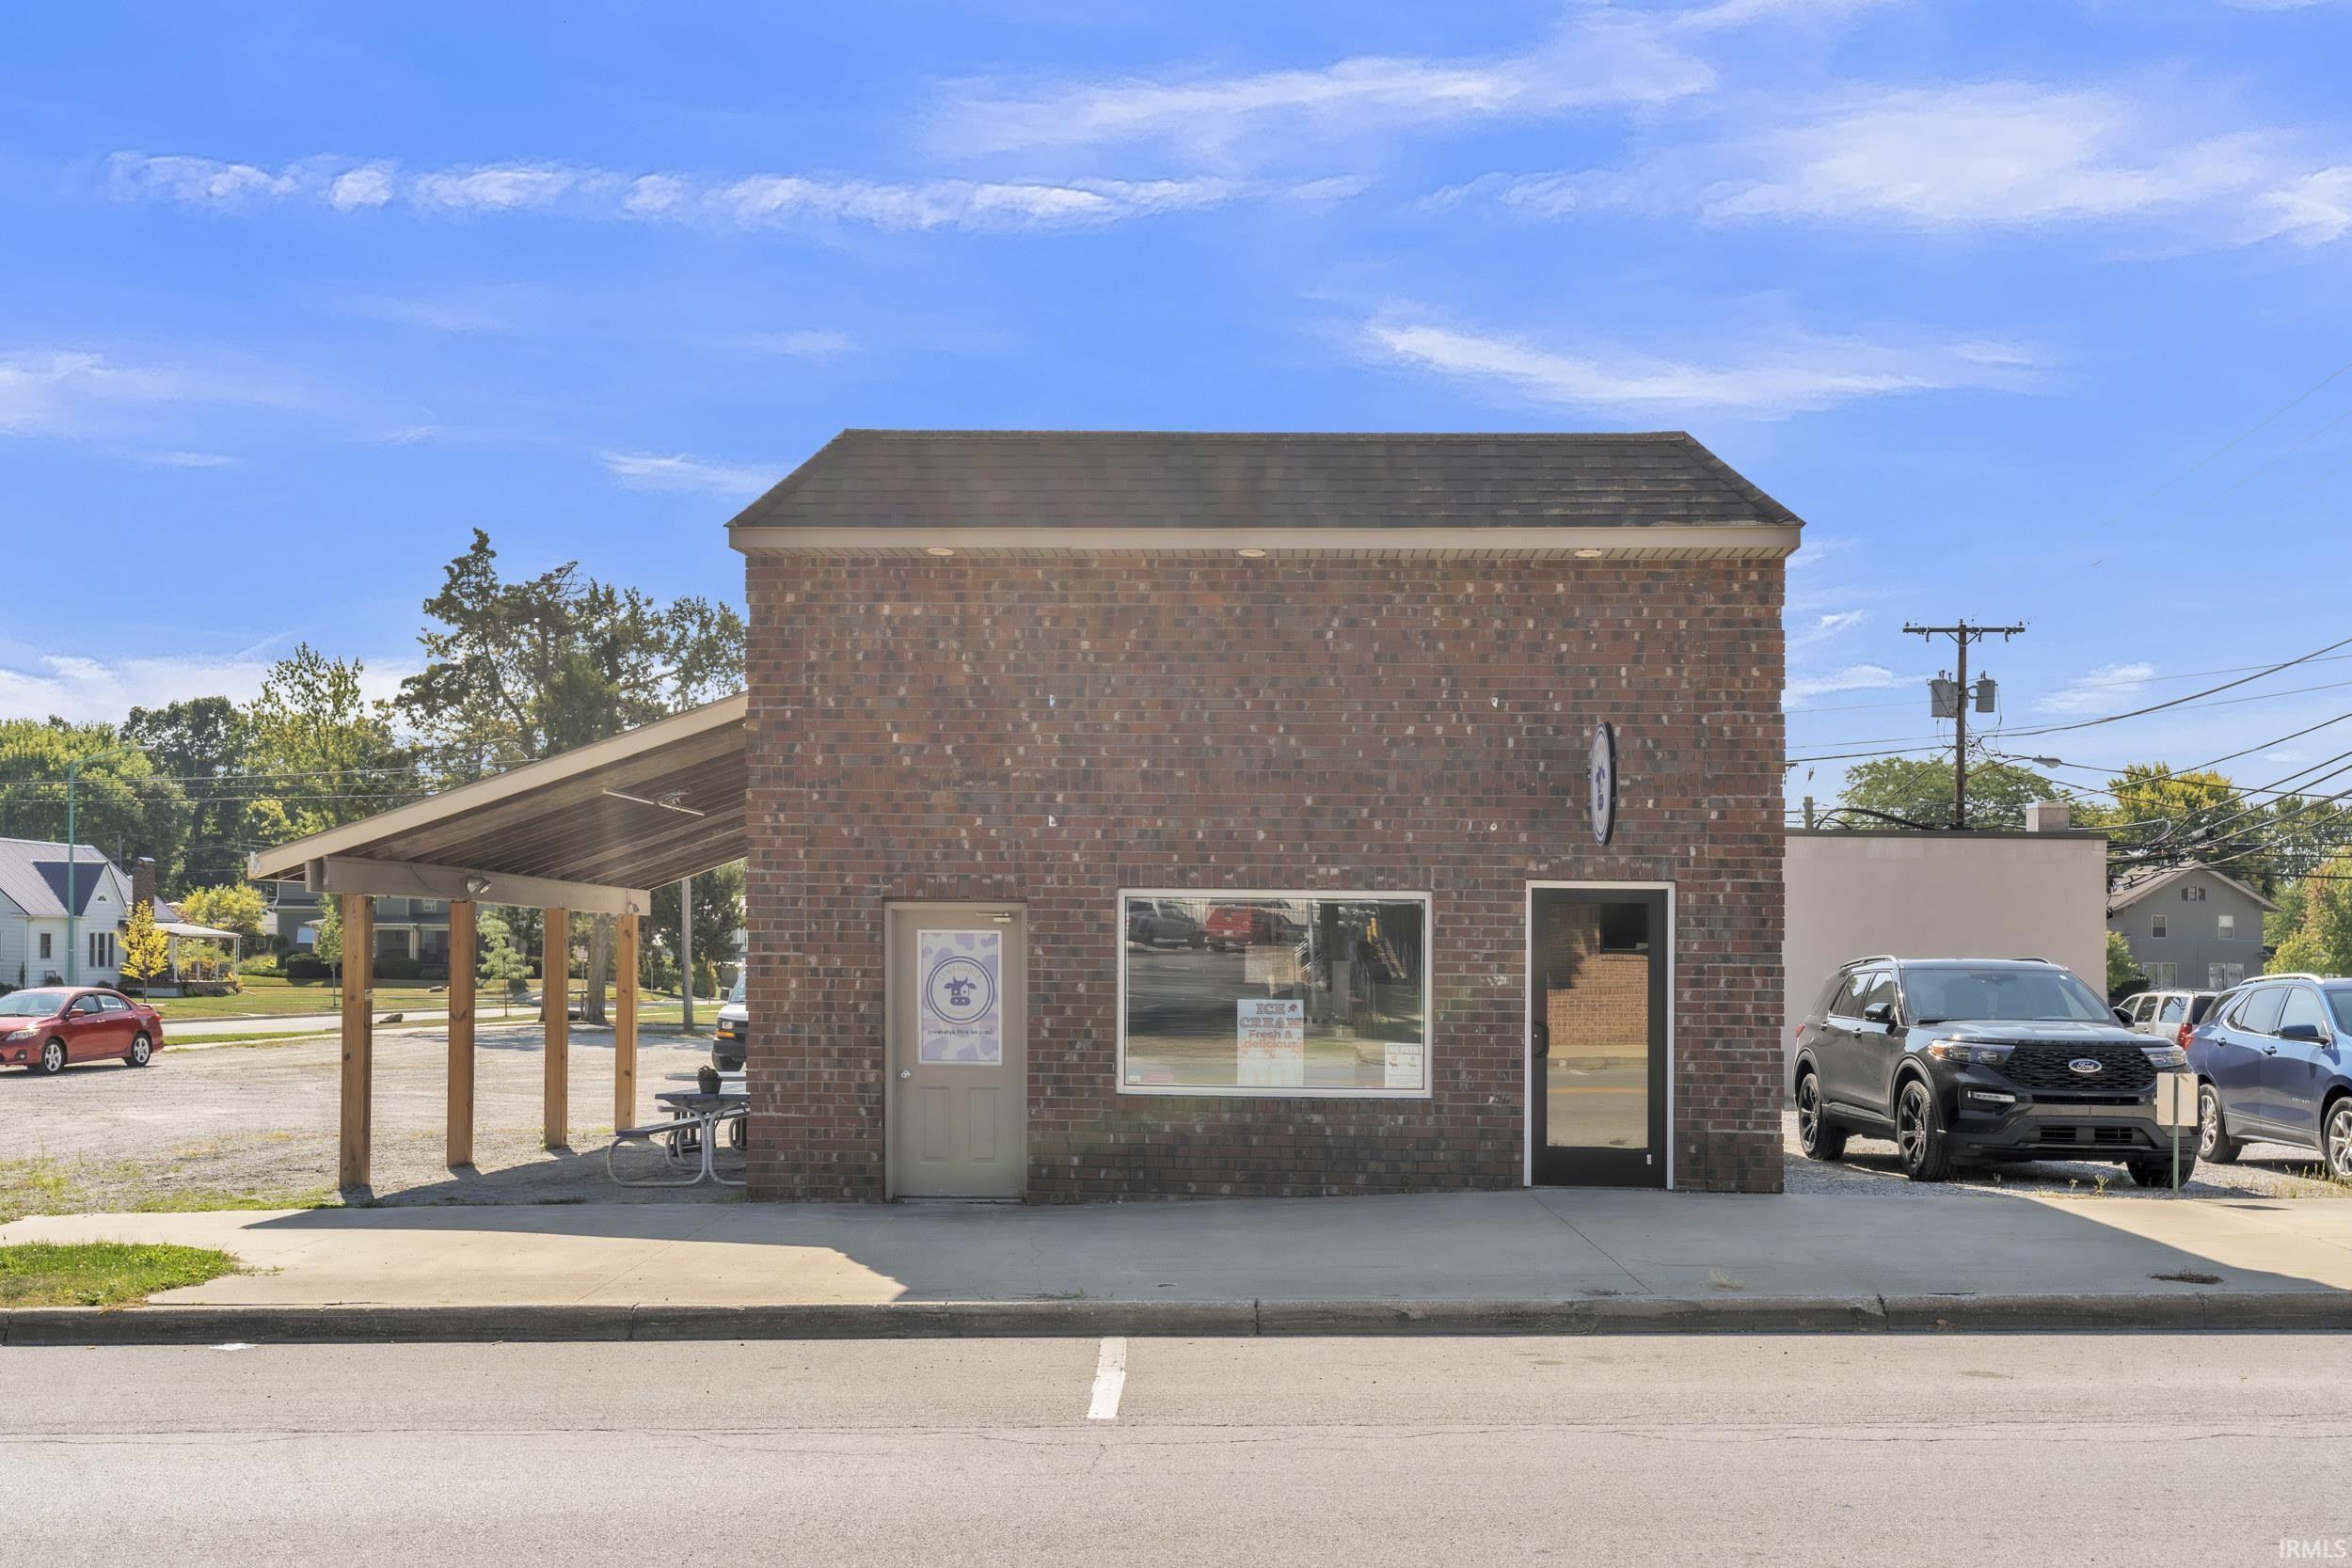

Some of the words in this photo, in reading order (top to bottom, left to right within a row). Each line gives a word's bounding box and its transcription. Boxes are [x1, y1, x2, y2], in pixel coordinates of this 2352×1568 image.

[1256, 1003, 1285, 1015] ICE
[1239, 1017, 1303, 1028] CREAM
[1248, 1029, 1281, 1039] Fresh
[1284, 1030, 1293, 1039] &
[1244, 1038, 1301, 1049] delicious
[2077, 1061, 2094, 1069] Ford
